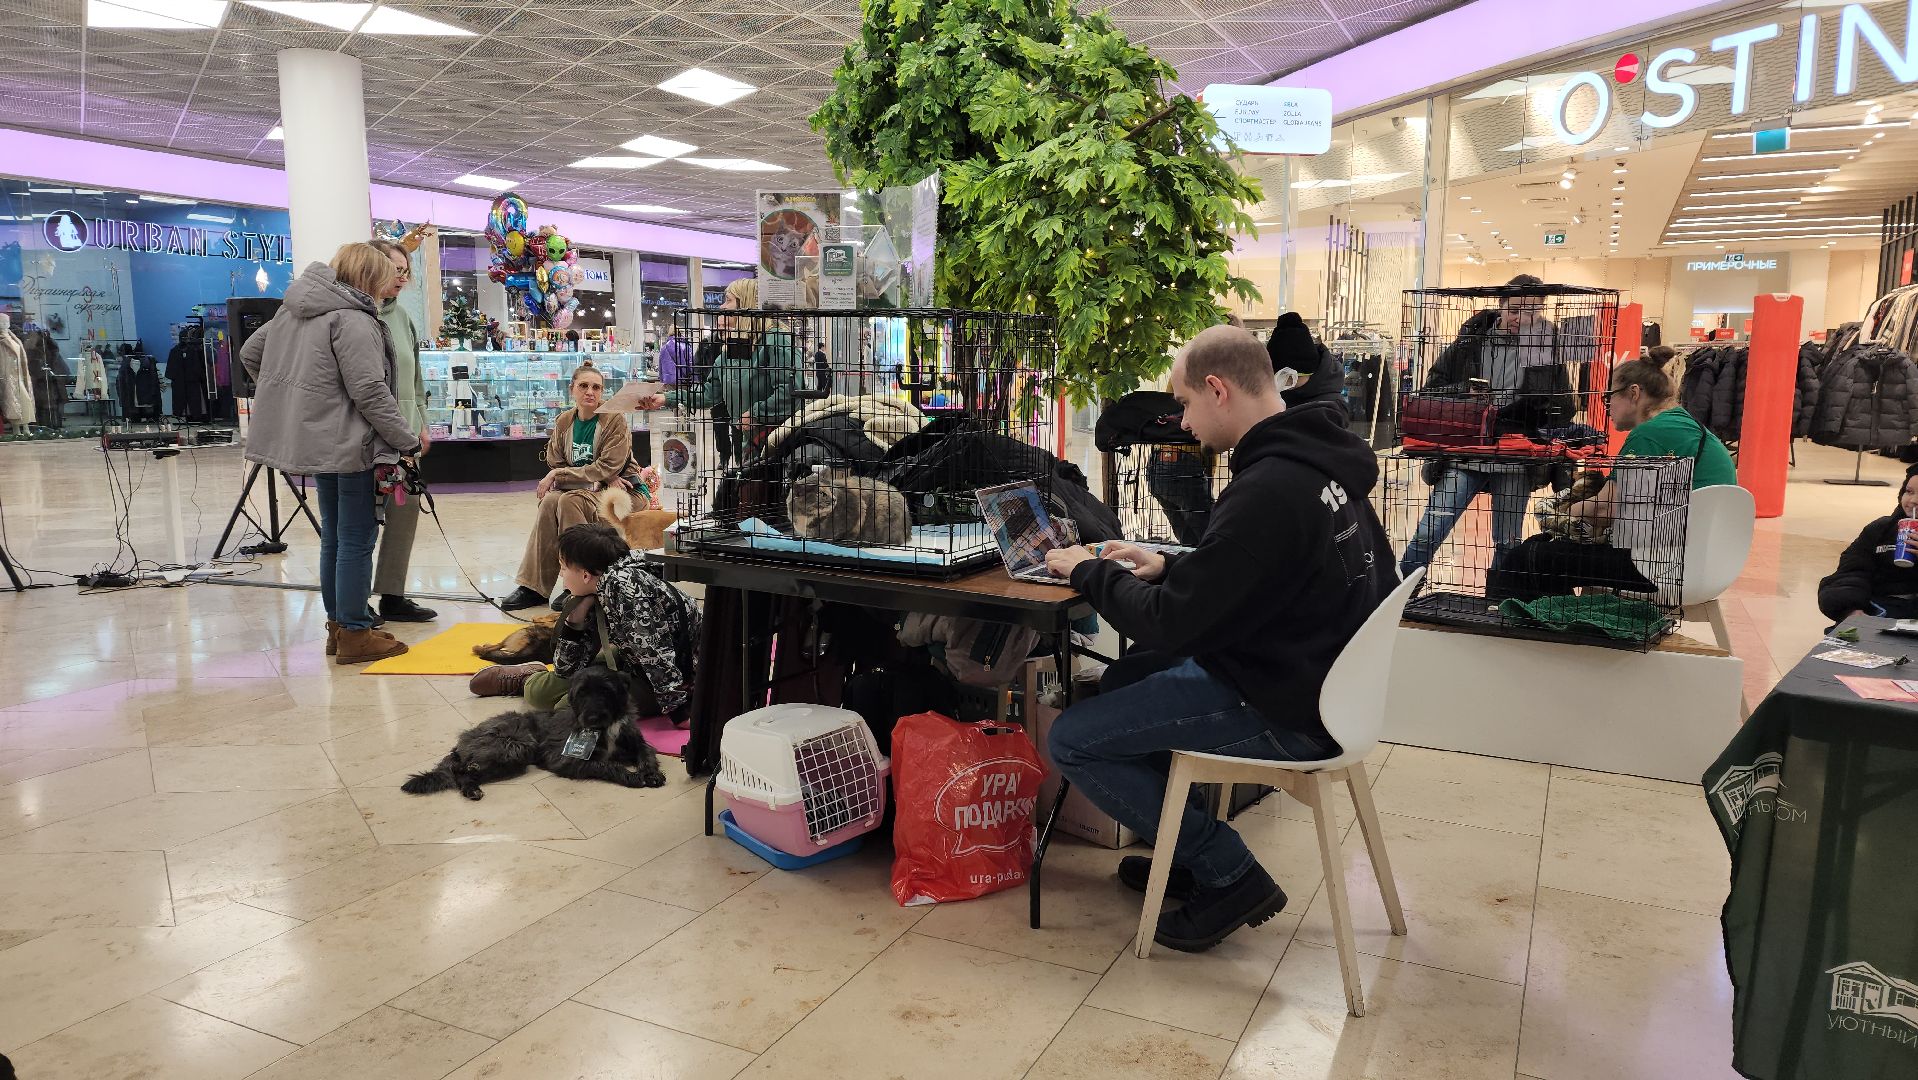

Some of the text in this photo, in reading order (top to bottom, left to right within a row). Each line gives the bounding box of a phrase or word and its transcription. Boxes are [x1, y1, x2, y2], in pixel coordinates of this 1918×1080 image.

[95, 217, 208, 257] URBAN
[1687, 259, 1777, 271] ПРИМЕРОЧНЫЕ
[1827, 1013, 1918, 1049] УЮТНЫЙ
